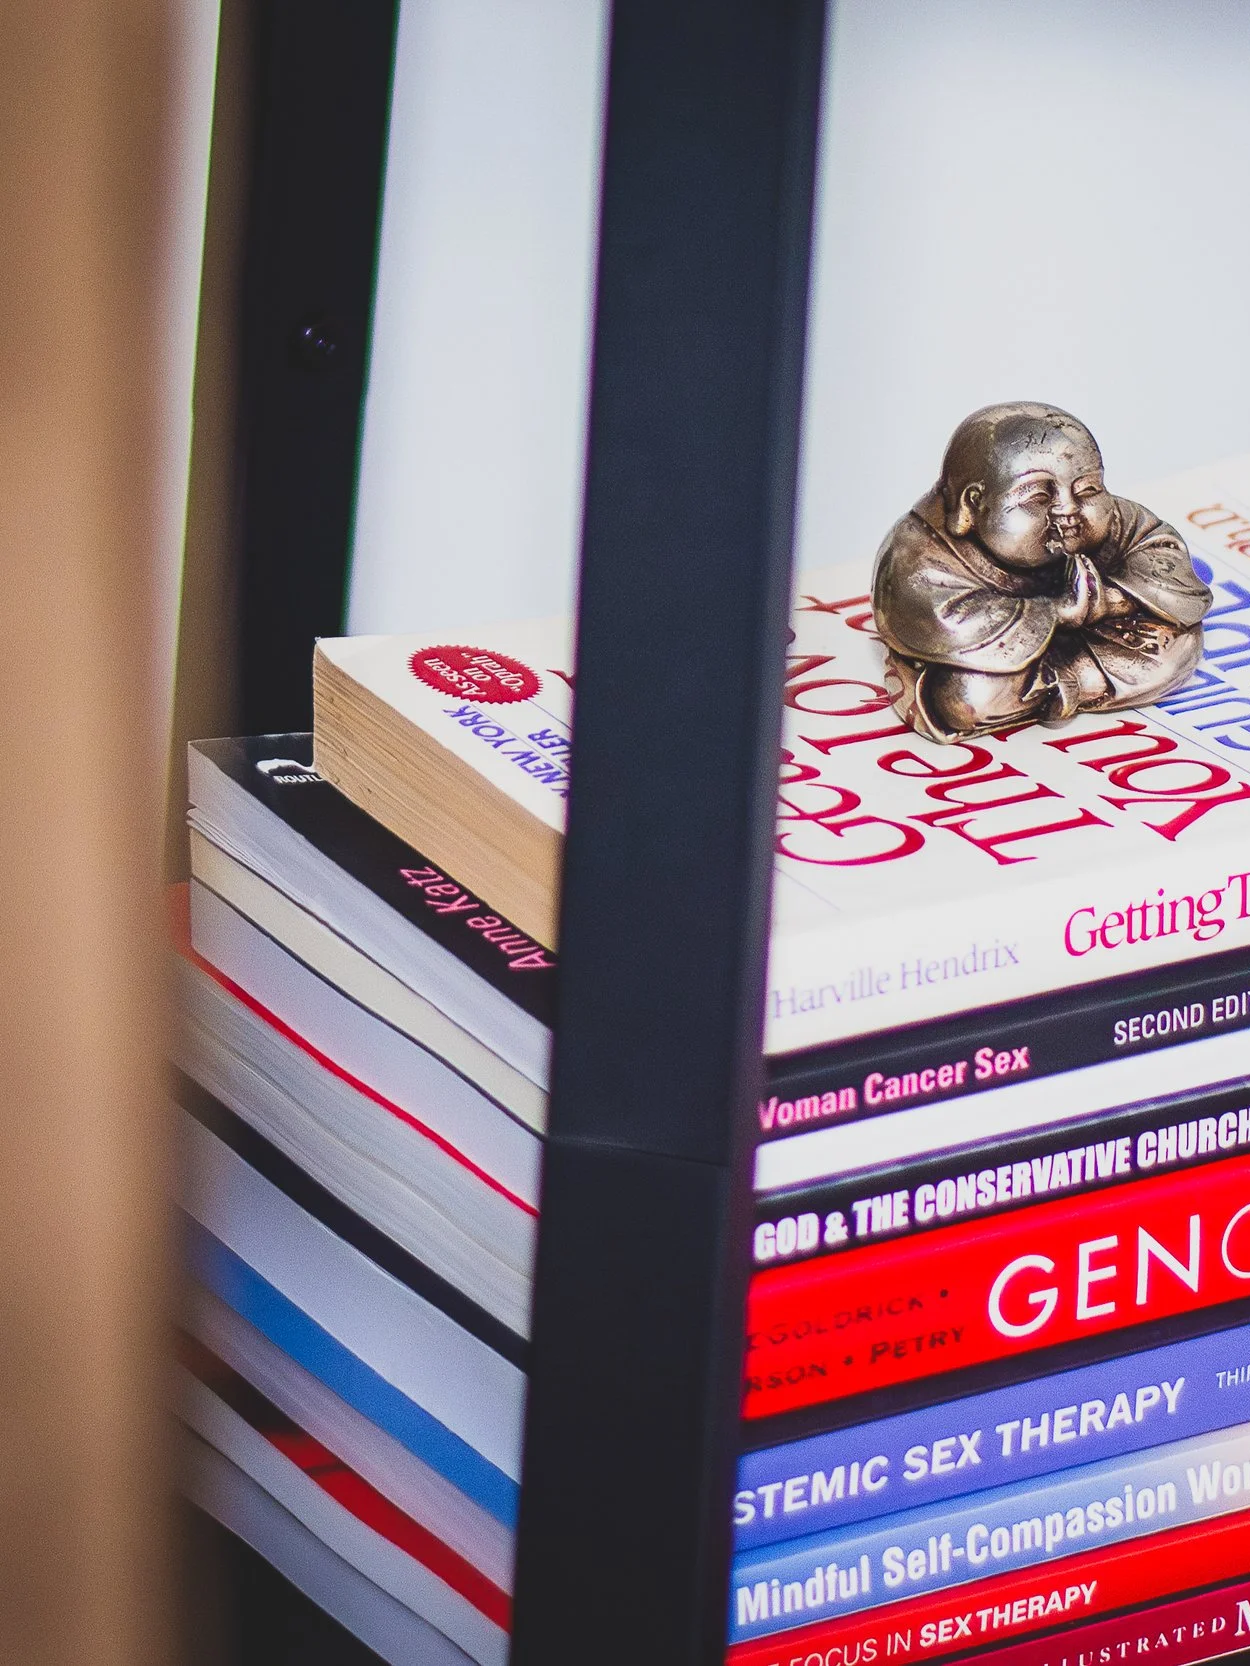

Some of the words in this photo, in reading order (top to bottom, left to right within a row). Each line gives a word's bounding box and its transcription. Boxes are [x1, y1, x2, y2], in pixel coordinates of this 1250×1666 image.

[423, 657, 467, 683] seen
[456, 681, 488, 696] As
[462, 667, 492, 682] on
[443, 704, 517, 750] YORK
[501, 751, 570, 785] NEW
[400, 866, 481, 917] Katz
[466, 914, 557, 973] Anne
[1063, 888, 1226, 958] Getting
[770, 964, 891, 1021] Harville
[899, 938, 1021, 991] Hendrix
[1113, 1001, 1204, 1046] SECOND
[864, 1058, 968, 1106] Cancer
[974, 1045, 1031, 1081] Sex
[753, 1216, 820, 1262] GOD
[823, 1208, 849, 1243] &
[852, 1190, 909, 1238] THE
[914, 1136, 1131, 1222] CONSERVATIVE
[868, 1326, 965, 1366] PETRY
[902, 1429, 983, 1483] SEX
[996, 1376, 1187, 1457] THERAPY
[736, 1550, 870, 1628] Mindful
[883, 1479, 1178, 1588] Self-Compassion
[886, 1628, 912, 1657] IN
[918, 1613, 973, 1648] SEX
[974, 1580, 1099, 1634] THERAPY
